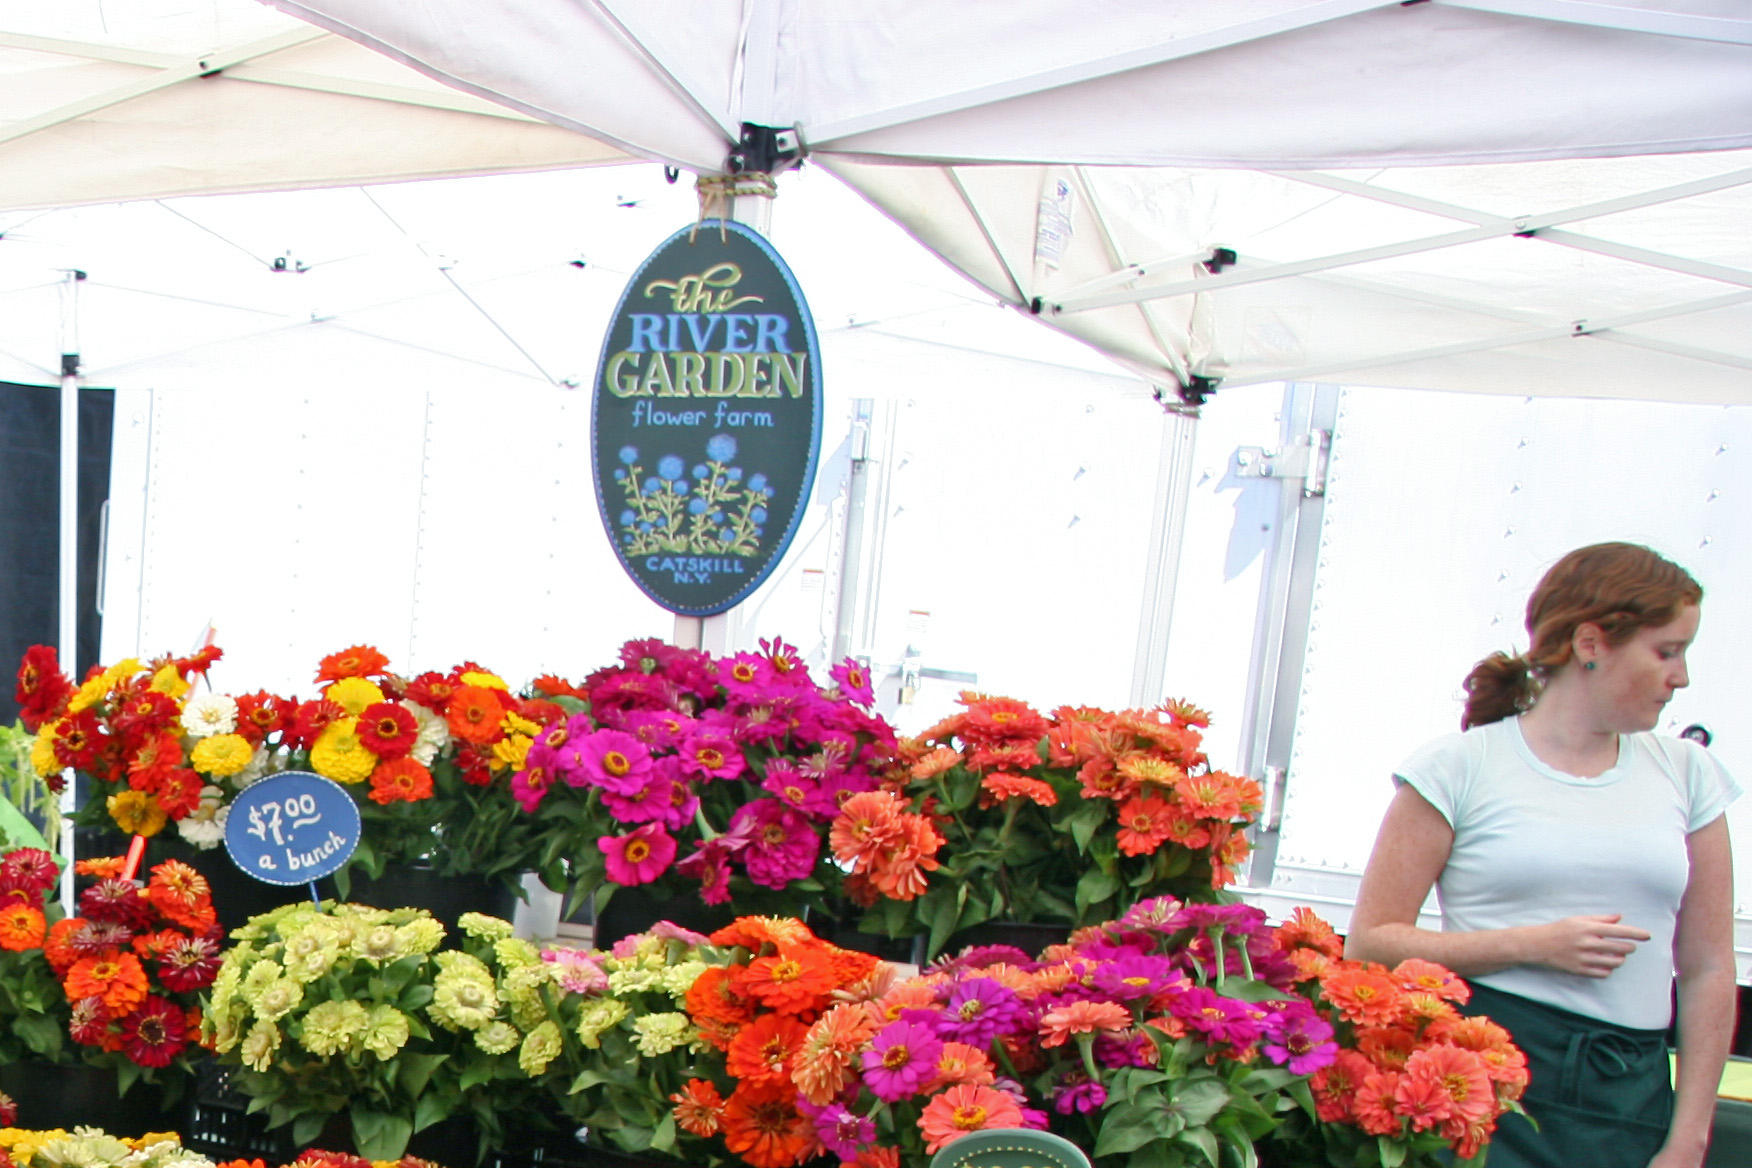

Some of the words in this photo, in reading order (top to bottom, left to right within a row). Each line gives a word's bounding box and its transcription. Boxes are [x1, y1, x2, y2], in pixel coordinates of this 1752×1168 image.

[644, 262, 764, 314] the
[626, 313, 792, 353] RIVER
[606, 350, 807, 398] GARDEN
[631, 400, 706, 427] flower
[713, 401, 775, 427] farm
[645, 556, 744, 573] CATSKILL
[673, 572, 711, 584] N.Y.
[247, 794, 322, 846] $7.00
[259, 854, 277, 870] a
[286, 831, 347, 871] bunch
